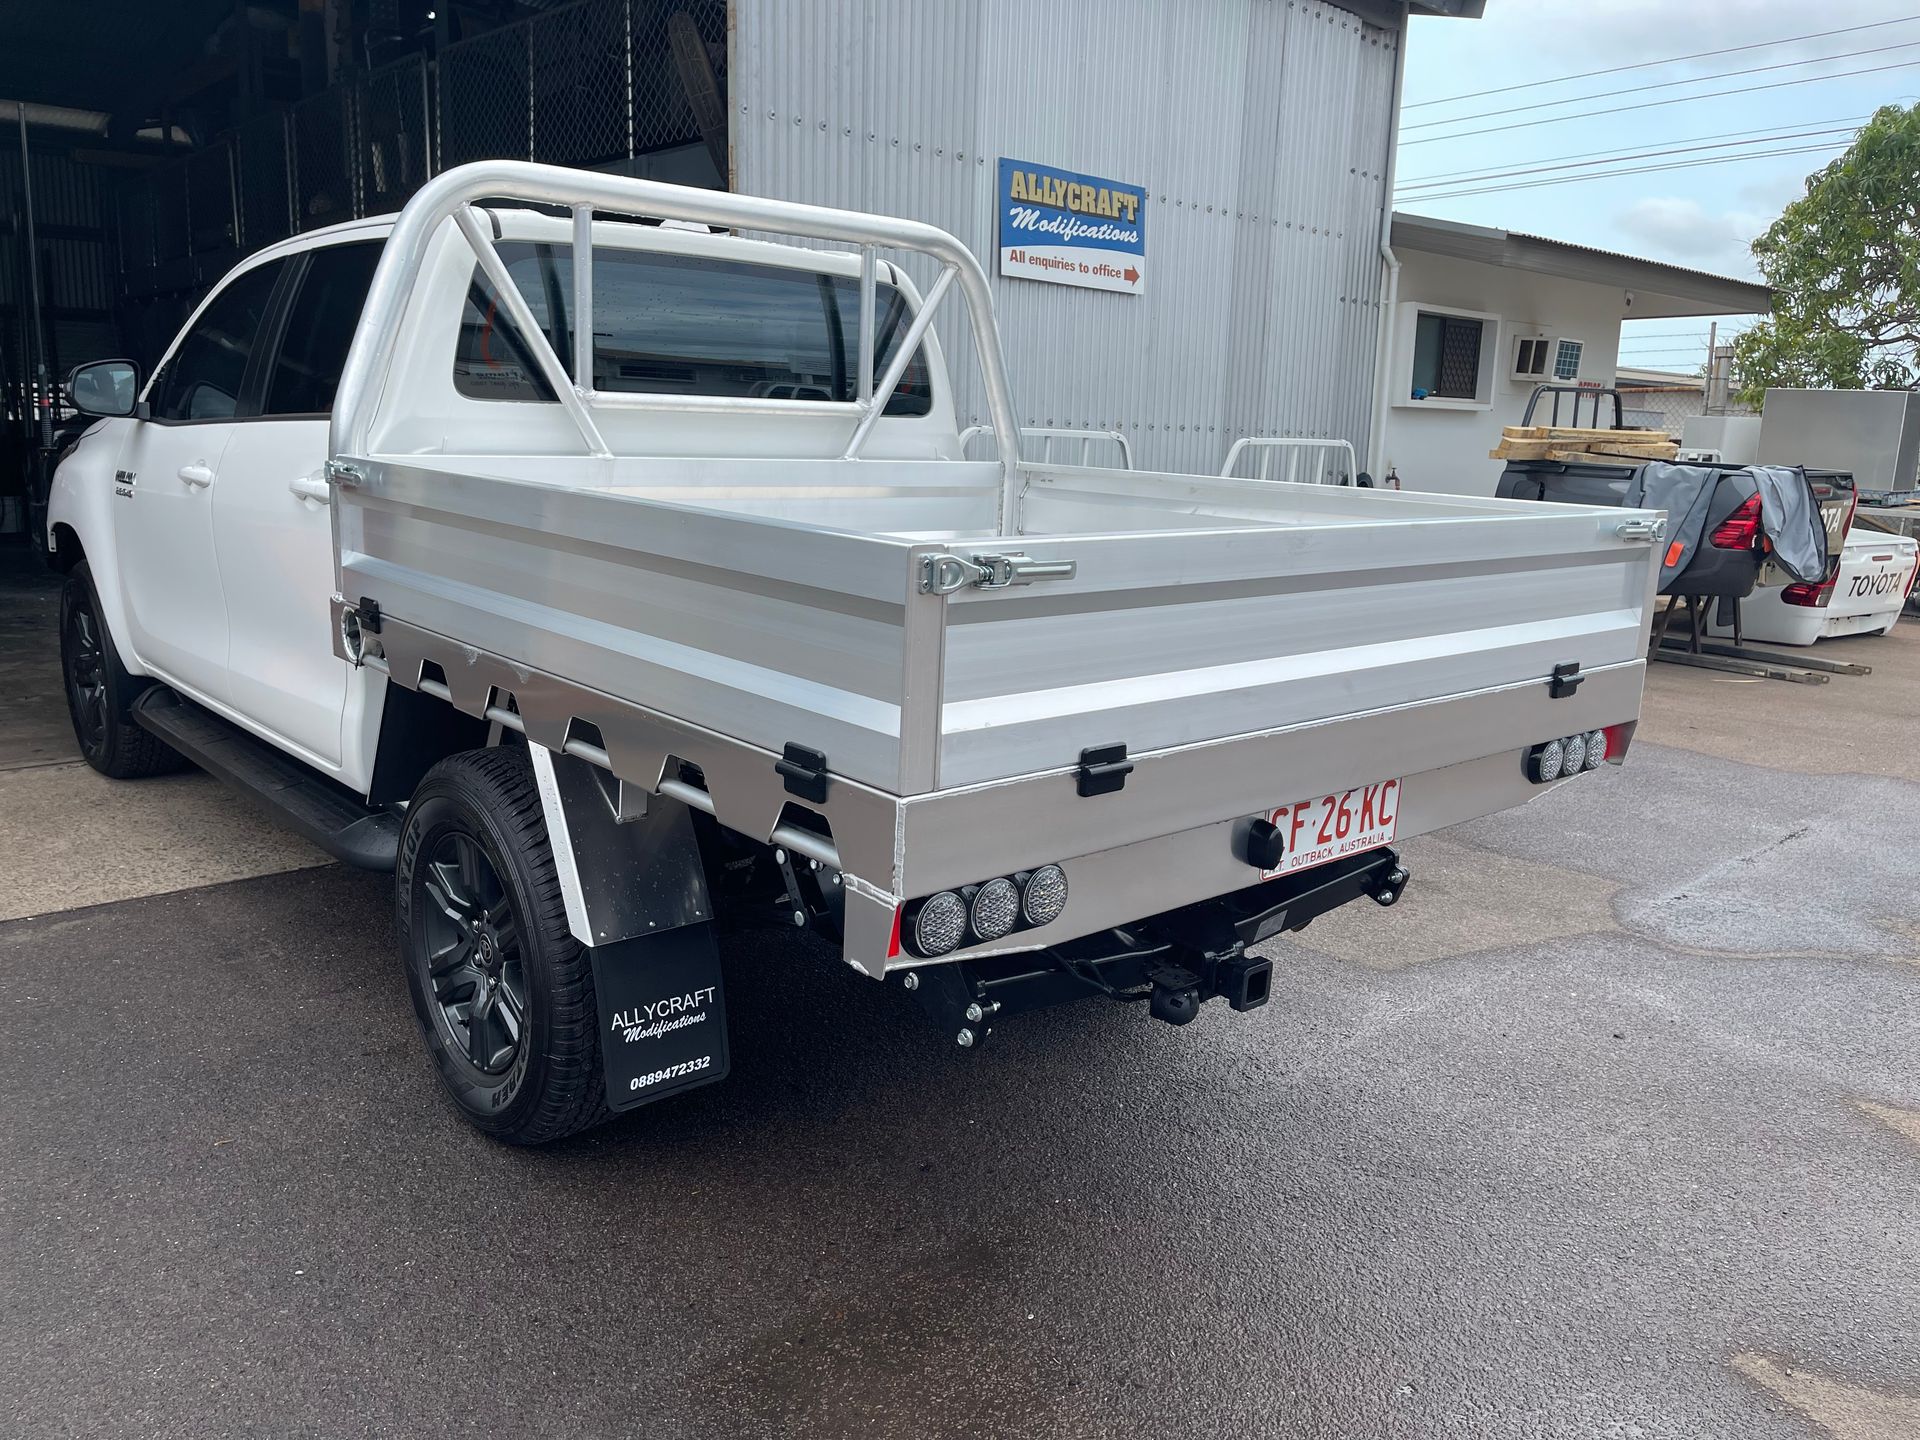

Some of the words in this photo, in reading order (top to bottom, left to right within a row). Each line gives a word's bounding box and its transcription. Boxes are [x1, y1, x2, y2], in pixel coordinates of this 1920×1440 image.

[1010, 170, 1139, 223] ALLYCRAFT
[1010, 206, 1139, 243] Modifications
[1009, 249, 1025, 264] All
[1029, 256, 1075, 271] enquiries
[1079, 262, 1089, 274] to
[1092, 263, 1121, 278] office
[1848, 572, 1902, 597] TOYOTA
[1291, 847, 1333, 866] OUTBACK
[1339, 832, 1385, 854] AUSTRALIA
[611, 986, 715, 1031] ALLYCRAFT
[623, 1011, 706, 1043] Modifications
[630, 1056, 711, 1090] 0889472332
